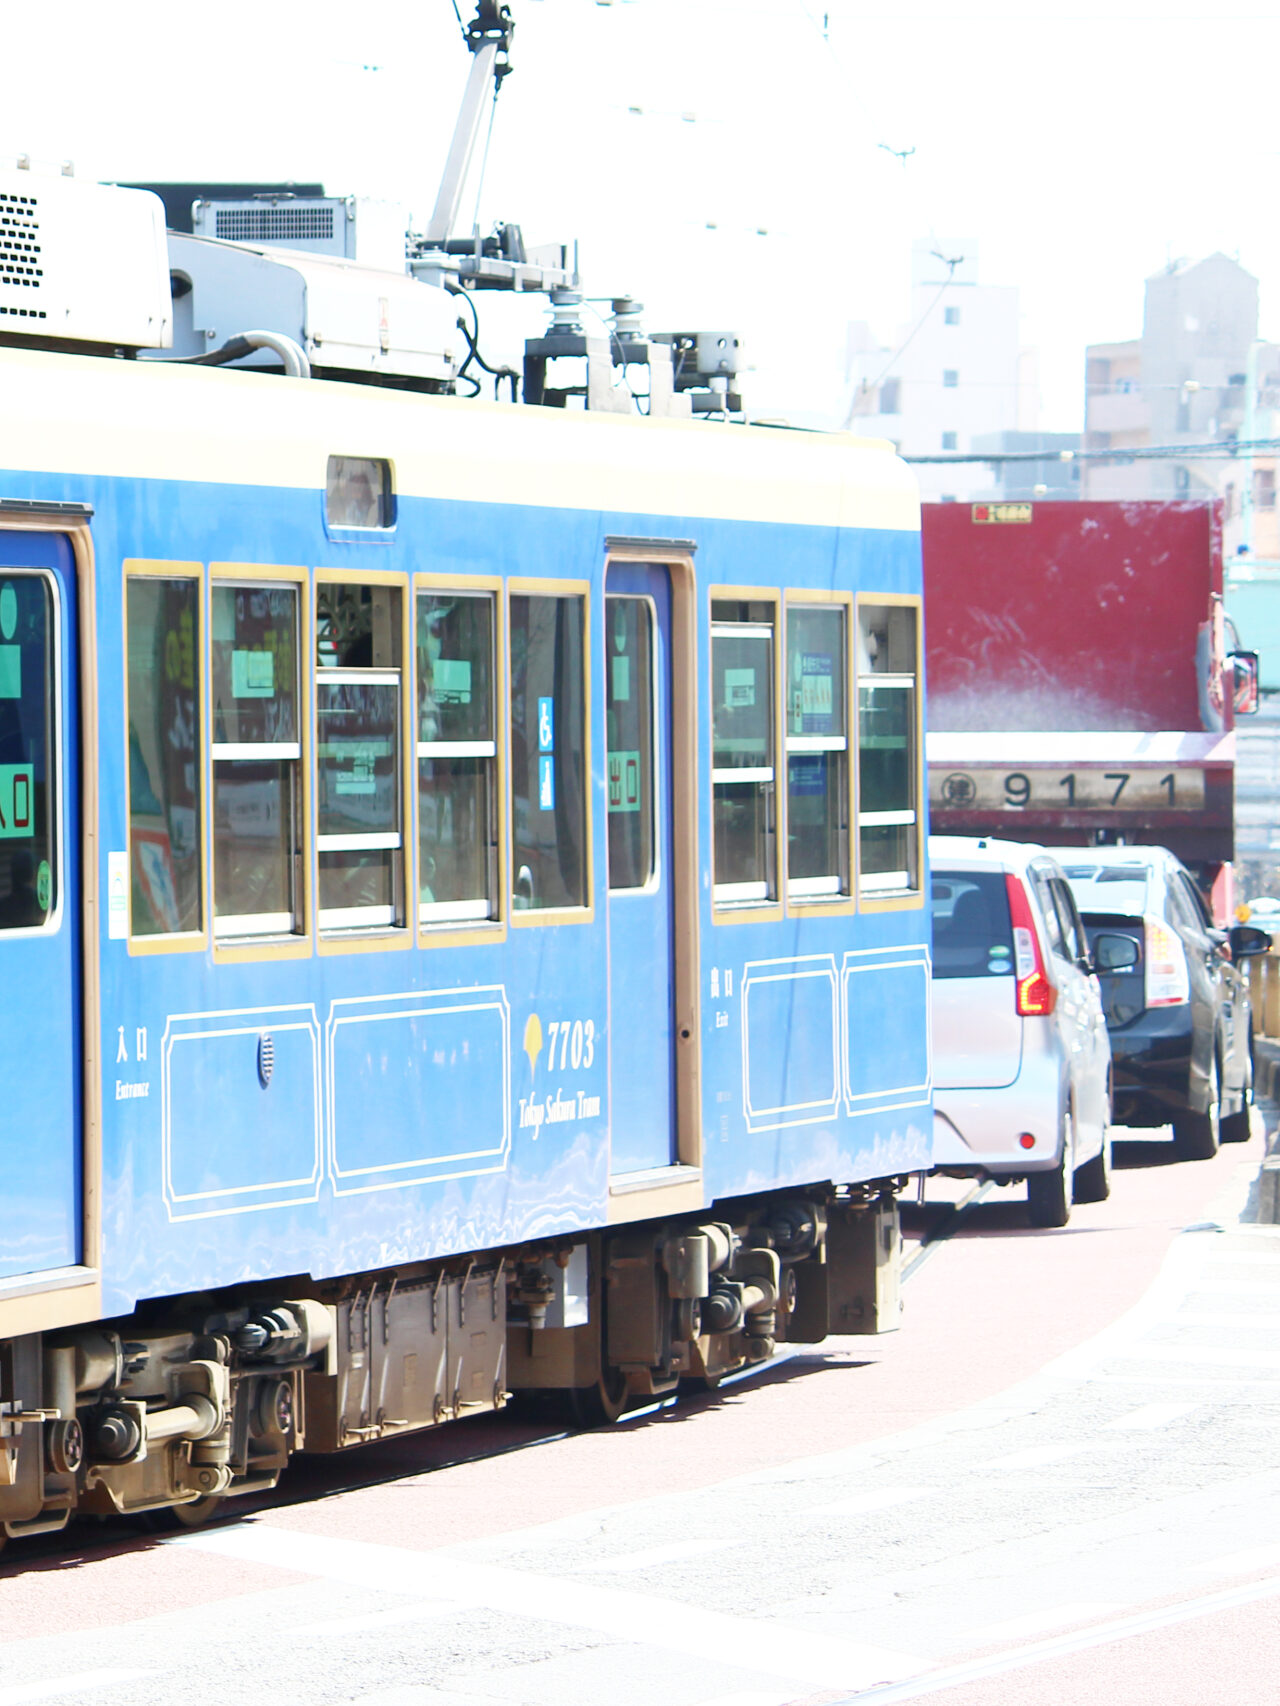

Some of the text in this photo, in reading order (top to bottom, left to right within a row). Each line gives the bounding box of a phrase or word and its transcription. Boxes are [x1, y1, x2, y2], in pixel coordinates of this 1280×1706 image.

[609, 757, 638, 806] 出口
[1004, 773, 1177, 807] 9171
[116, 1025, 148, 1063] 入口
[547, 1019, 595, 1072] 7703
[519, 1088, 601, 1141] Tokyo Sakura Tram
